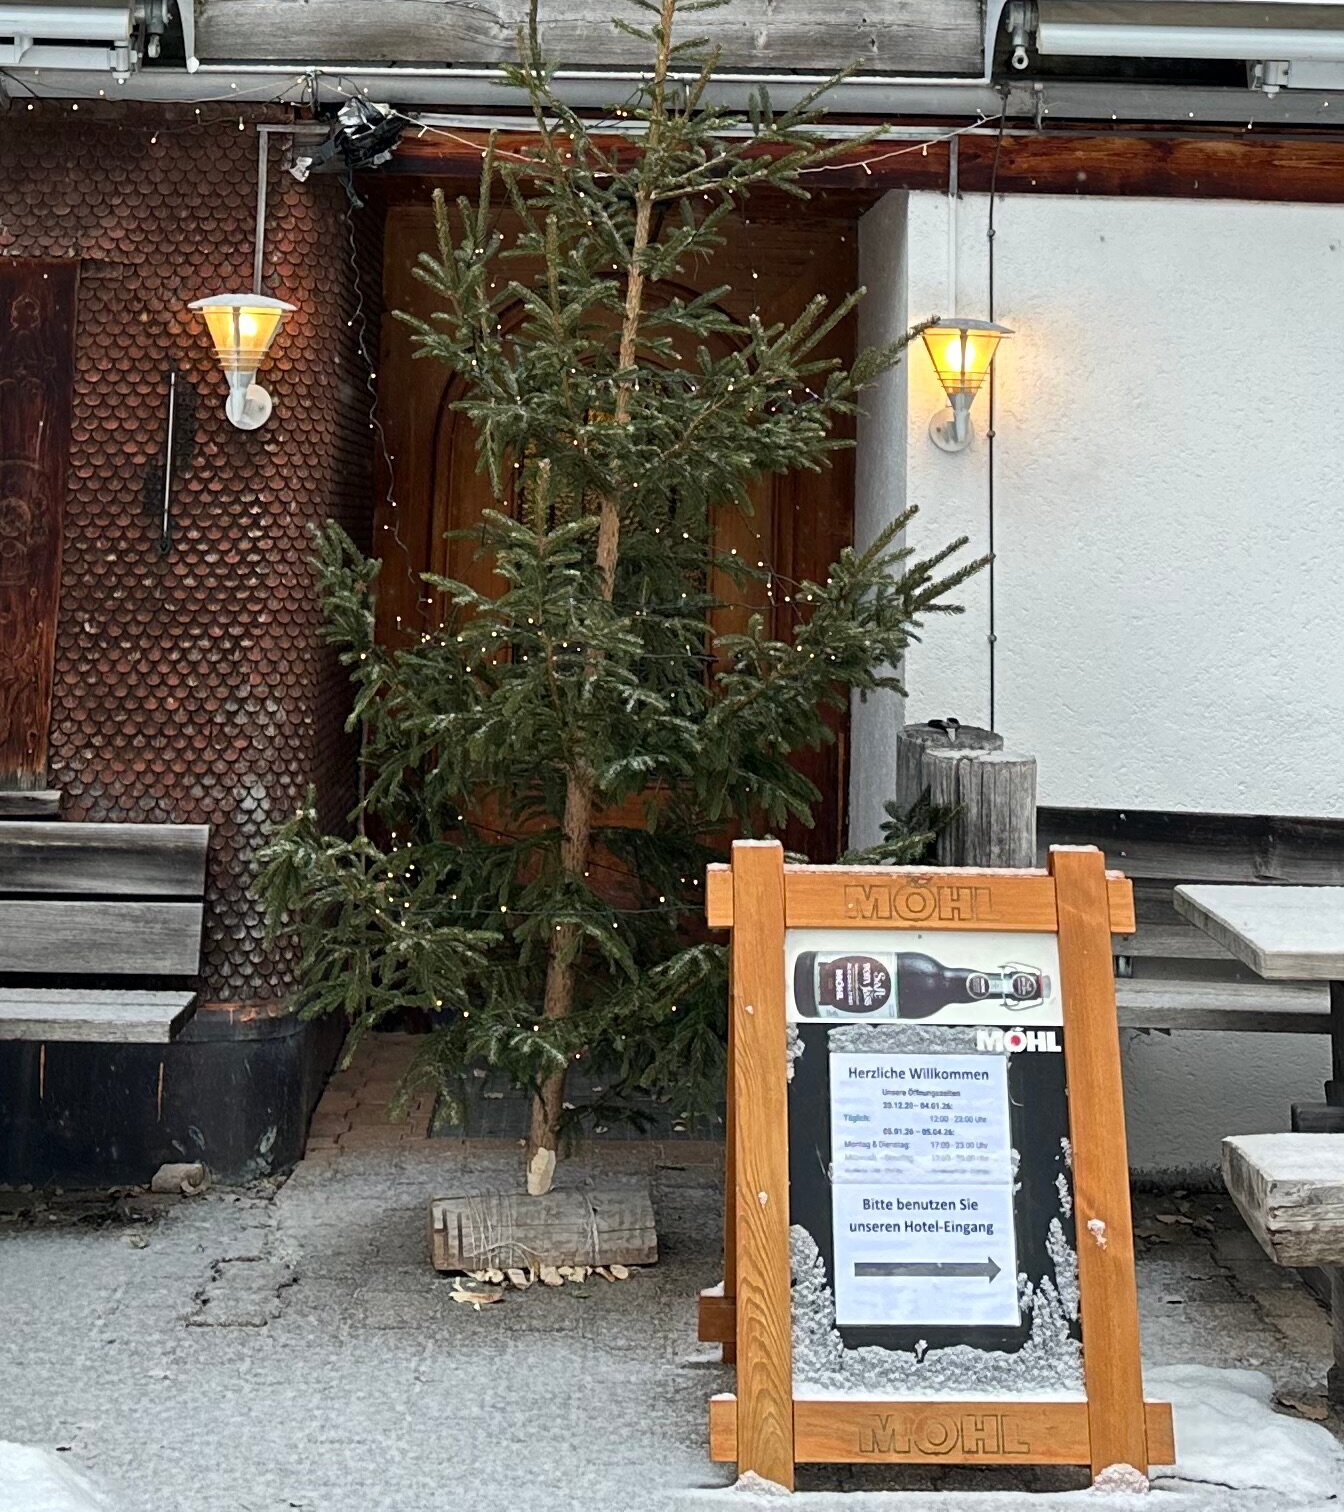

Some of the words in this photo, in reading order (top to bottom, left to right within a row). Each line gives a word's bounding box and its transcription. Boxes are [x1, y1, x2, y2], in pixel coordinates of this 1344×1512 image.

[848, 1067, 906, 1080] Herzliche
[908, 1067, 990, 1081] Willkommen
[862, 1198, 894, 1211] Bitte
[896, 1198, 956, 1211] benutzen
[959, 1198, 979, 1211] Sie
[849, 1222, 901, 1233] unseren
[904, 1220, 994, 1236] Hotel-Eingang
